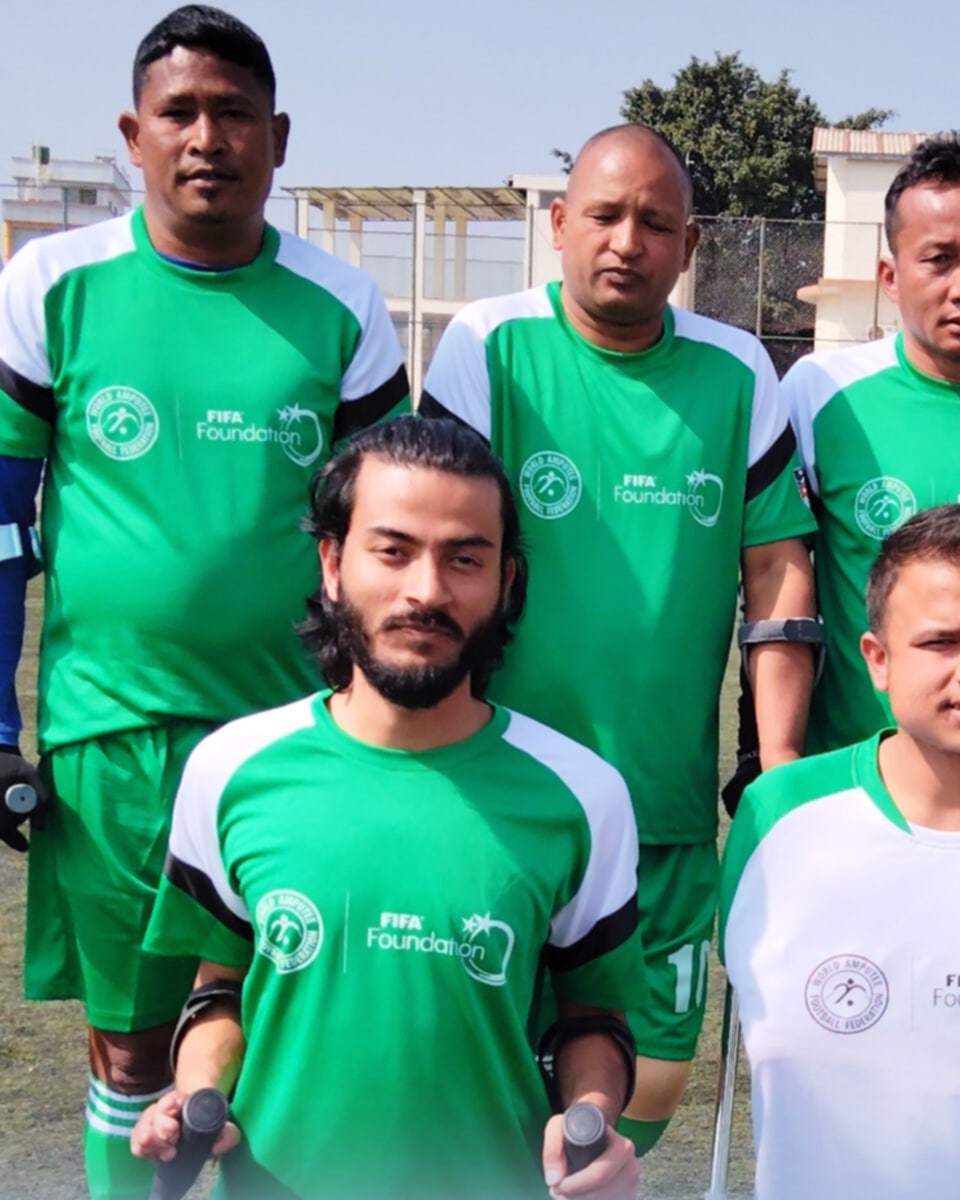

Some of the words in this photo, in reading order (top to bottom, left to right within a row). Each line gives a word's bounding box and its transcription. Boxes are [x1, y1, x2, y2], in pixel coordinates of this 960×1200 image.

[206, 410, 243, 423] FIFA
[196, 422, 300, 445] Foundation
[623, 474, 656, 488] FIFA
[613, 485, 704, 508] Foundation
[380, 911, 423, 931] FIFA
[366, 927, 485, 961] Foundation
[813, 959, 840, 987] WORLD
[844, 959, 884, 988] AMPUTEE
[809, 994, 841, 1030] FOOTBALL
[844, 992, 884, 1030] FEDERATION
